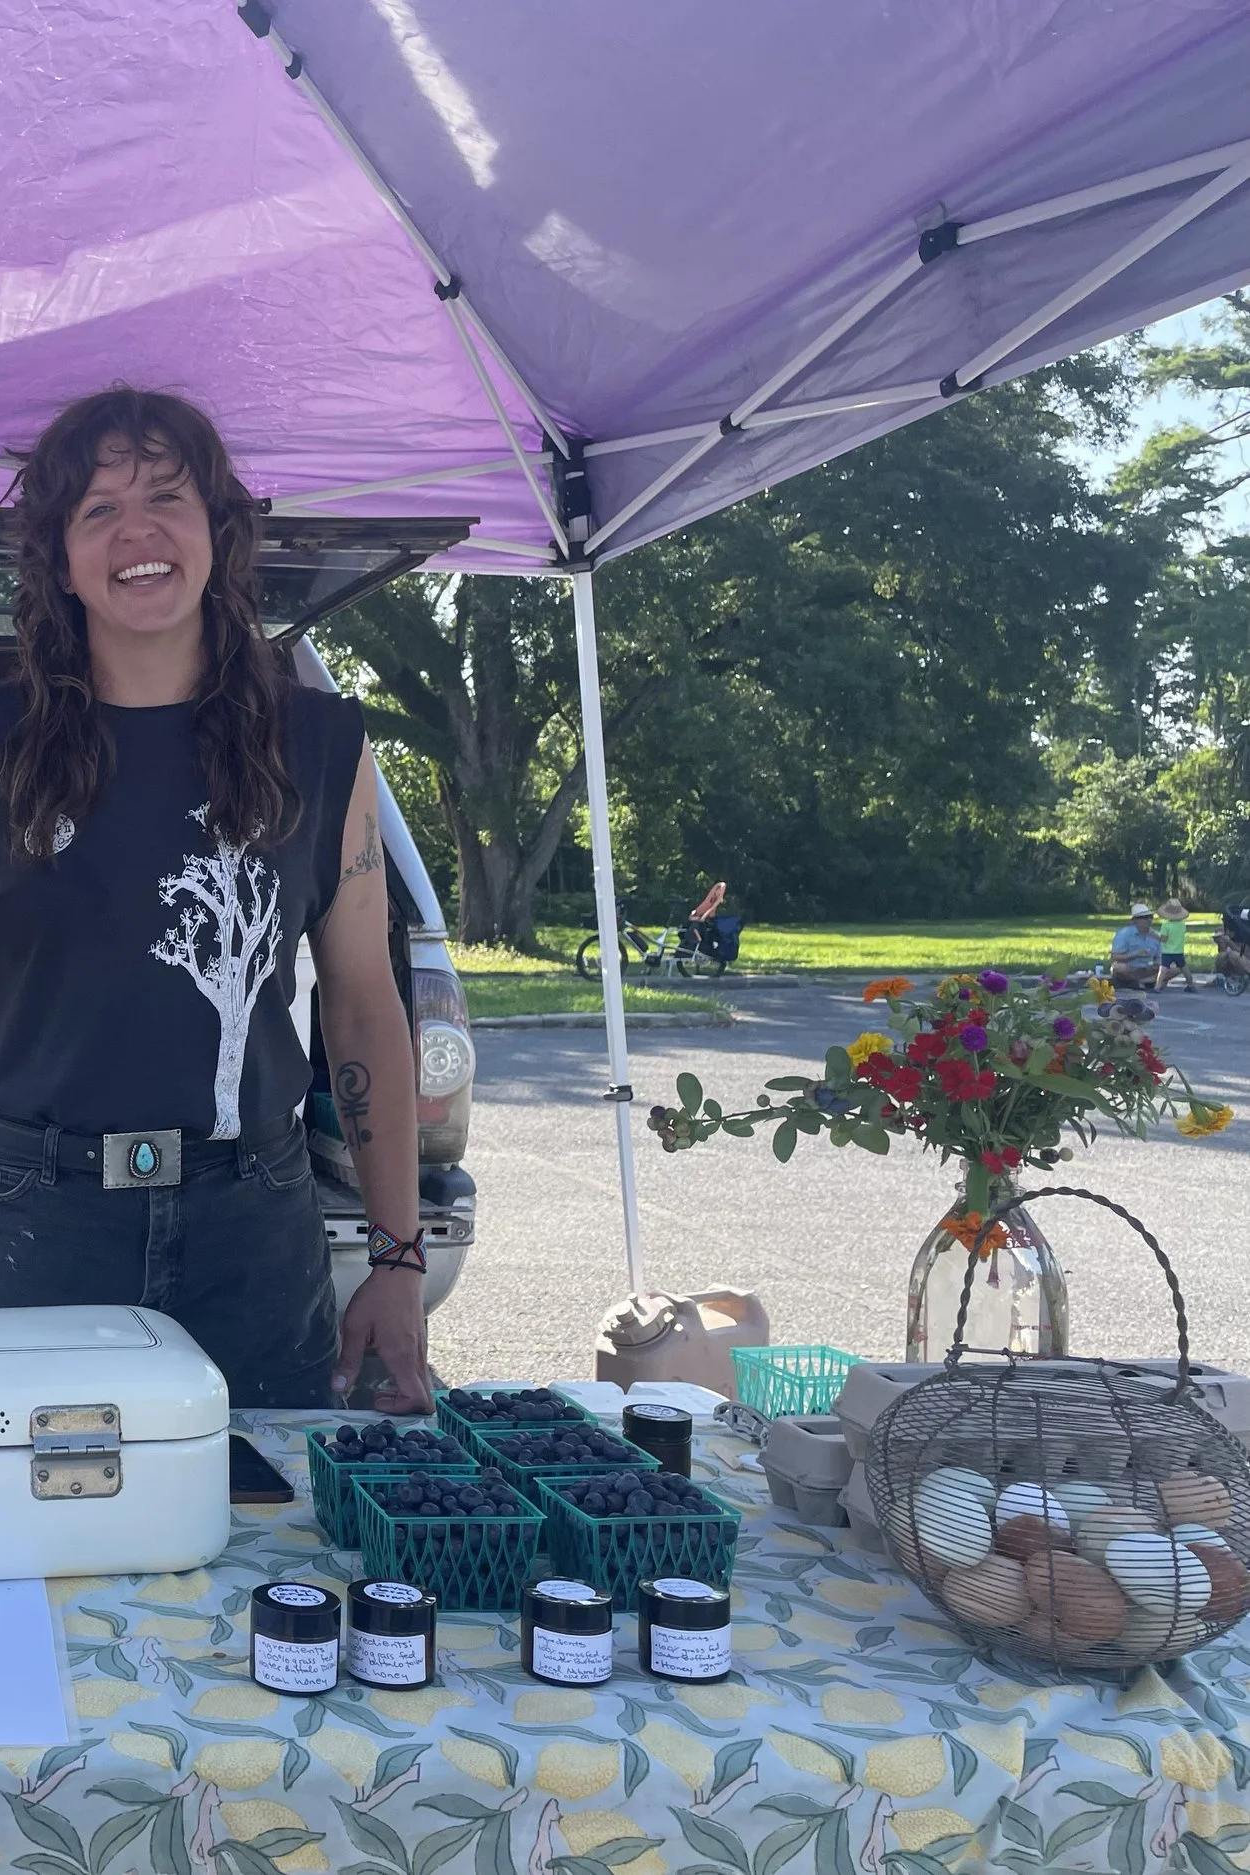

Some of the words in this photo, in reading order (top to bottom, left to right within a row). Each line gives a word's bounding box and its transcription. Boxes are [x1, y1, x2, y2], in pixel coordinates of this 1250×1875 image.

[399, 1650, 416, 1660] fed
[681, 1648, 706, 1657] grass
[708, 1641, 720, 1652] fed
[320, 1652, 334, 1663] fed
[660, 1659, 693, 1675] Honey
[372, 1669, 409, 1682] honey
[294, 1677, 328, 1687] honey
